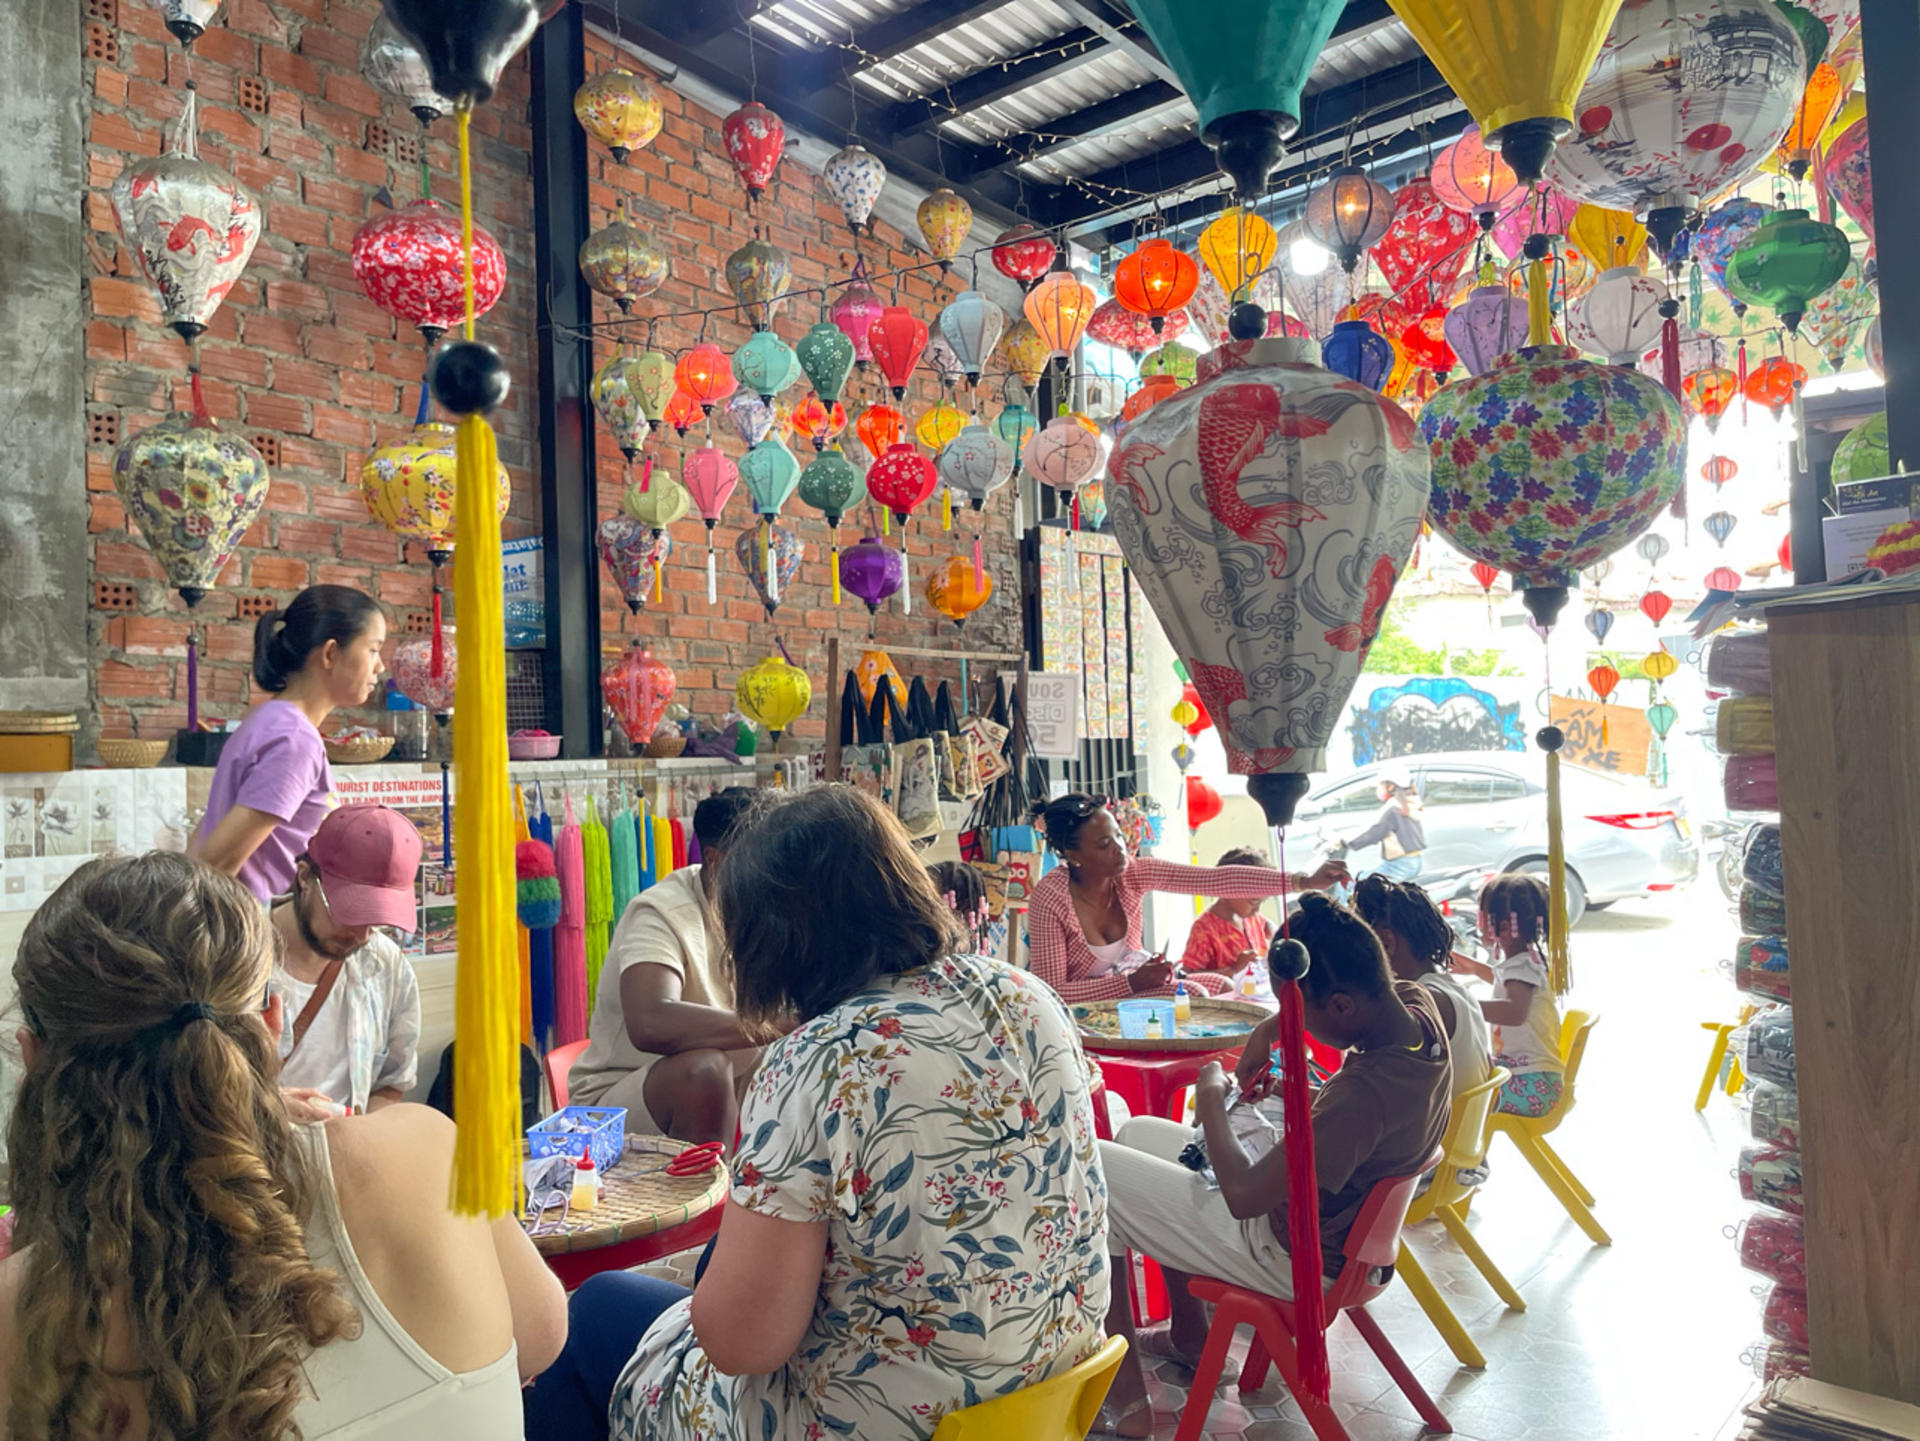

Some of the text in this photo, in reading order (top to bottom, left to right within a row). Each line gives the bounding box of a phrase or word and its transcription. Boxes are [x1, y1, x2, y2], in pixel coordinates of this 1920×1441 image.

[373, 780, 442, 793] DESTINATIONS
[381, 795, 403, 804] FROM
[406, 794, 418, 803] THE
